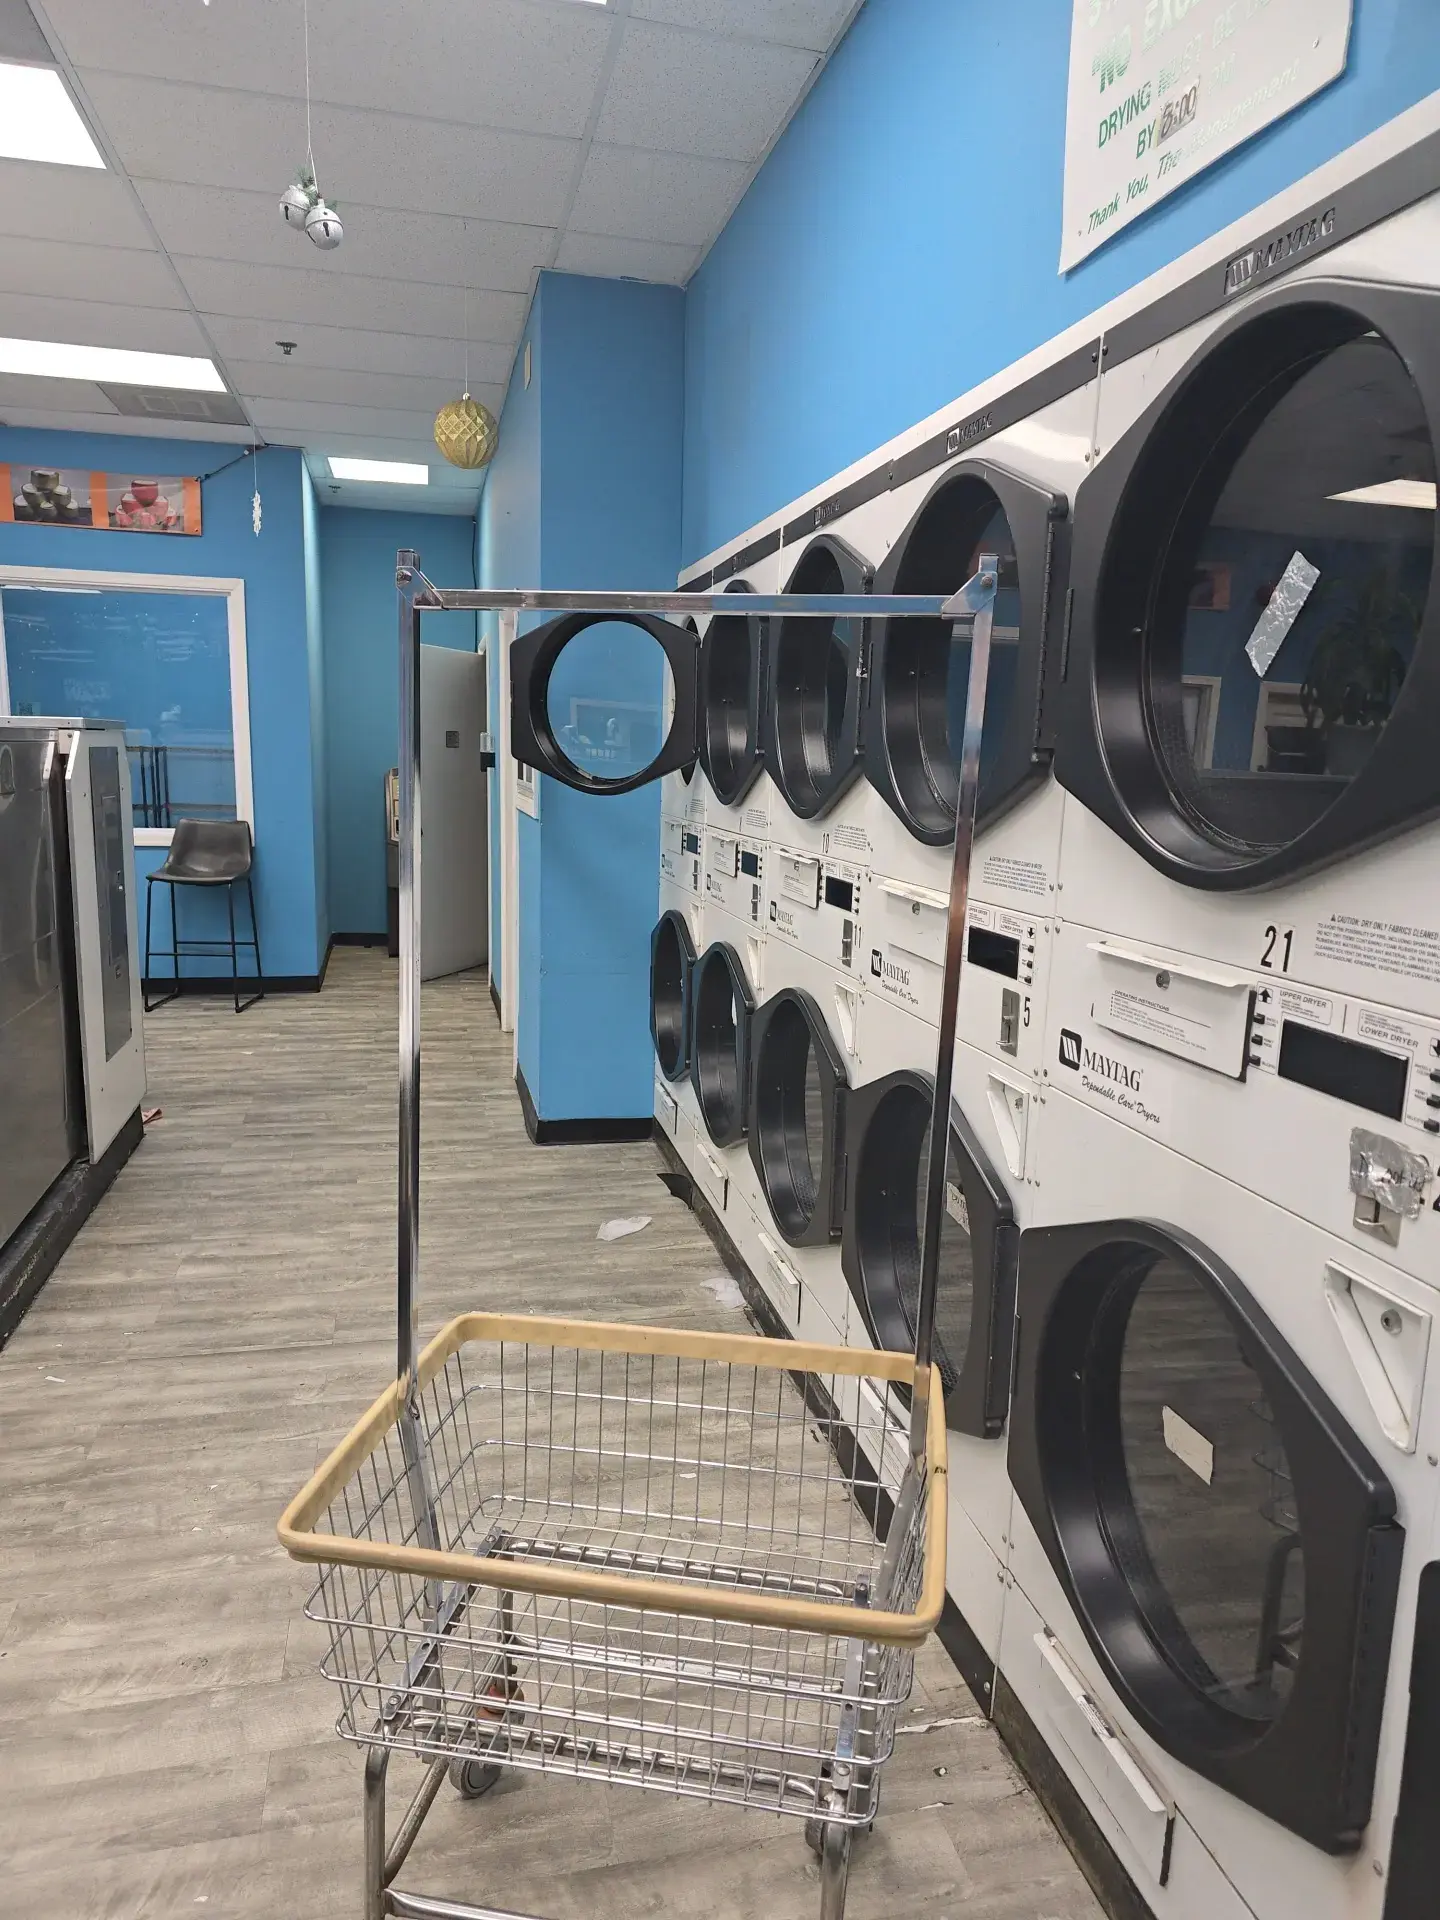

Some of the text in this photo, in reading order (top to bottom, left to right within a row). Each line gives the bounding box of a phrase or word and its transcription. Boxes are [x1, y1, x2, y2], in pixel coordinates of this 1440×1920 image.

[1098, 80, 1152, 149] DRYING
[1136, 119, 1157, 160] BY
[1088, 192, 1121, 235] Thank
[1126, 173, 1149, 204] You,
[1253, 206, 1336, 275] MAYTAG
[1260, 925, 1294, 973] 21
[882, 960, 909, 986] MAYTAG
[1023, 996, 1031, 1028] 5
[1114, 989, 1170, 1012] OPERATING INSTRUCTIONS
[1279, 990, 1301, 1001] UPPER
[1302, 994, 1327, 1009] DRYER
[1360, 1026, 1419, 1048] LOWER DRYER
[1083, 1047, 1141, 1092] MAYTAG
[1081, 1075, 1160, 1123] Dependable Care Dryers
